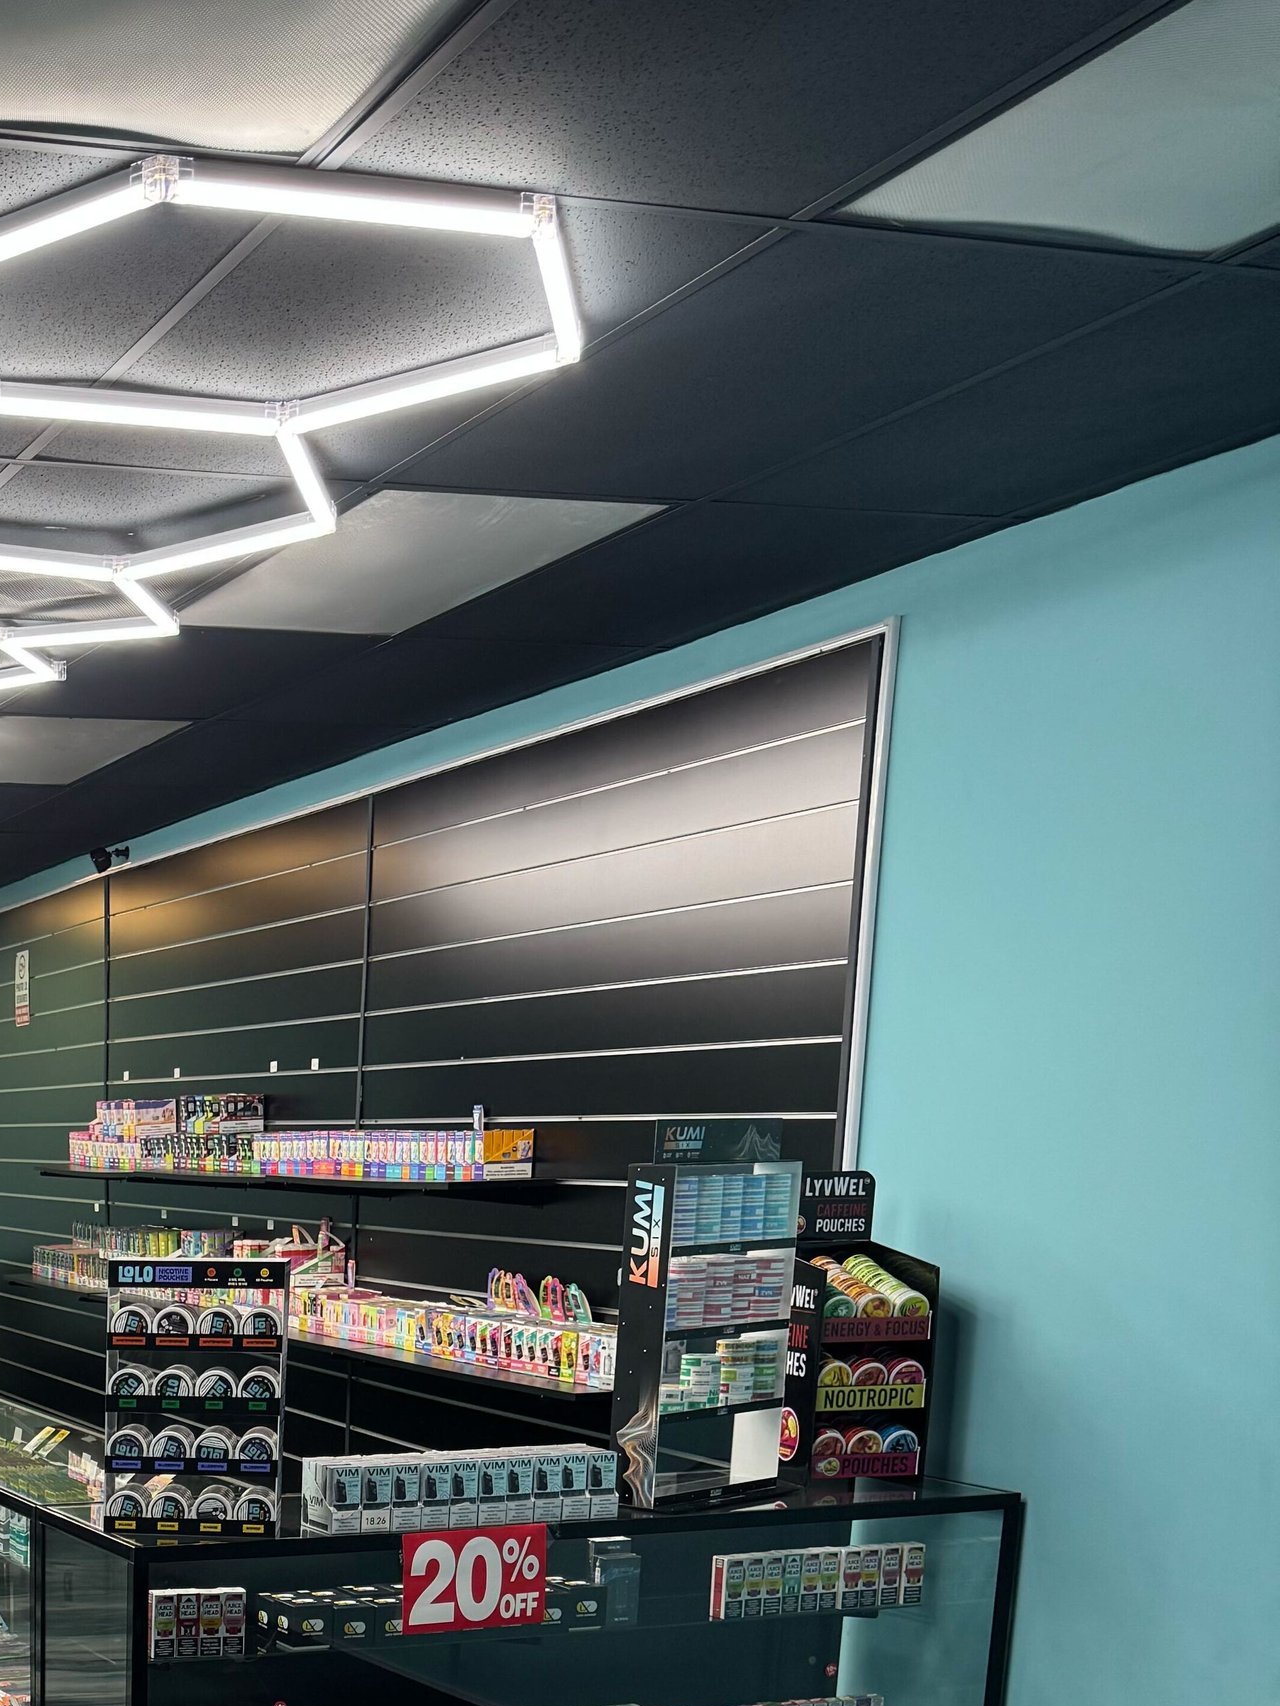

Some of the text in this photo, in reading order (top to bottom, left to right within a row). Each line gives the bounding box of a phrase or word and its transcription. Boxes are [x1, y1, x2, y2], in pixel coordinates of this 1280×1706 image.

[665, 1126, 706, 1141] KUMI
[805, 1177, 866, 1197] LYVWEL
[817, 1203, 867, 1217] CAFFEINE
[629, 1180, 653, 1285] KUMI
[815, 1218, 865, 1233] POUCHES
[650, 1218, 661, 1257] SIX
[118, 1266, 153, 1283] LOLO
[823, 1319, 926, 1337] ENERGY & FOCUS
[823, 1387, 915, 1409] NOOTROPIC
[483, 1461, 505, 1470] VIM
[509, 1459, 531, 1468] VIM
[538, 1457, 560, 1466] VIM
[563, 1455, 585, 1464] VIM
[592, 1454, 615, 1463] VIM
[841, 1456, 909, 1475] POUCHES
[336, 1469, 359, 1477] VIM
[367, 1468, 390, 1476] VIM
[396, 1466, 418, 1474] VIM
[427, 1465, 449, 1473] VIM
[454, 1463, 477, 1472] VIM
[408, 1536, 540, 1626] 20%
[500, 1592, 539, 1619] OFF
